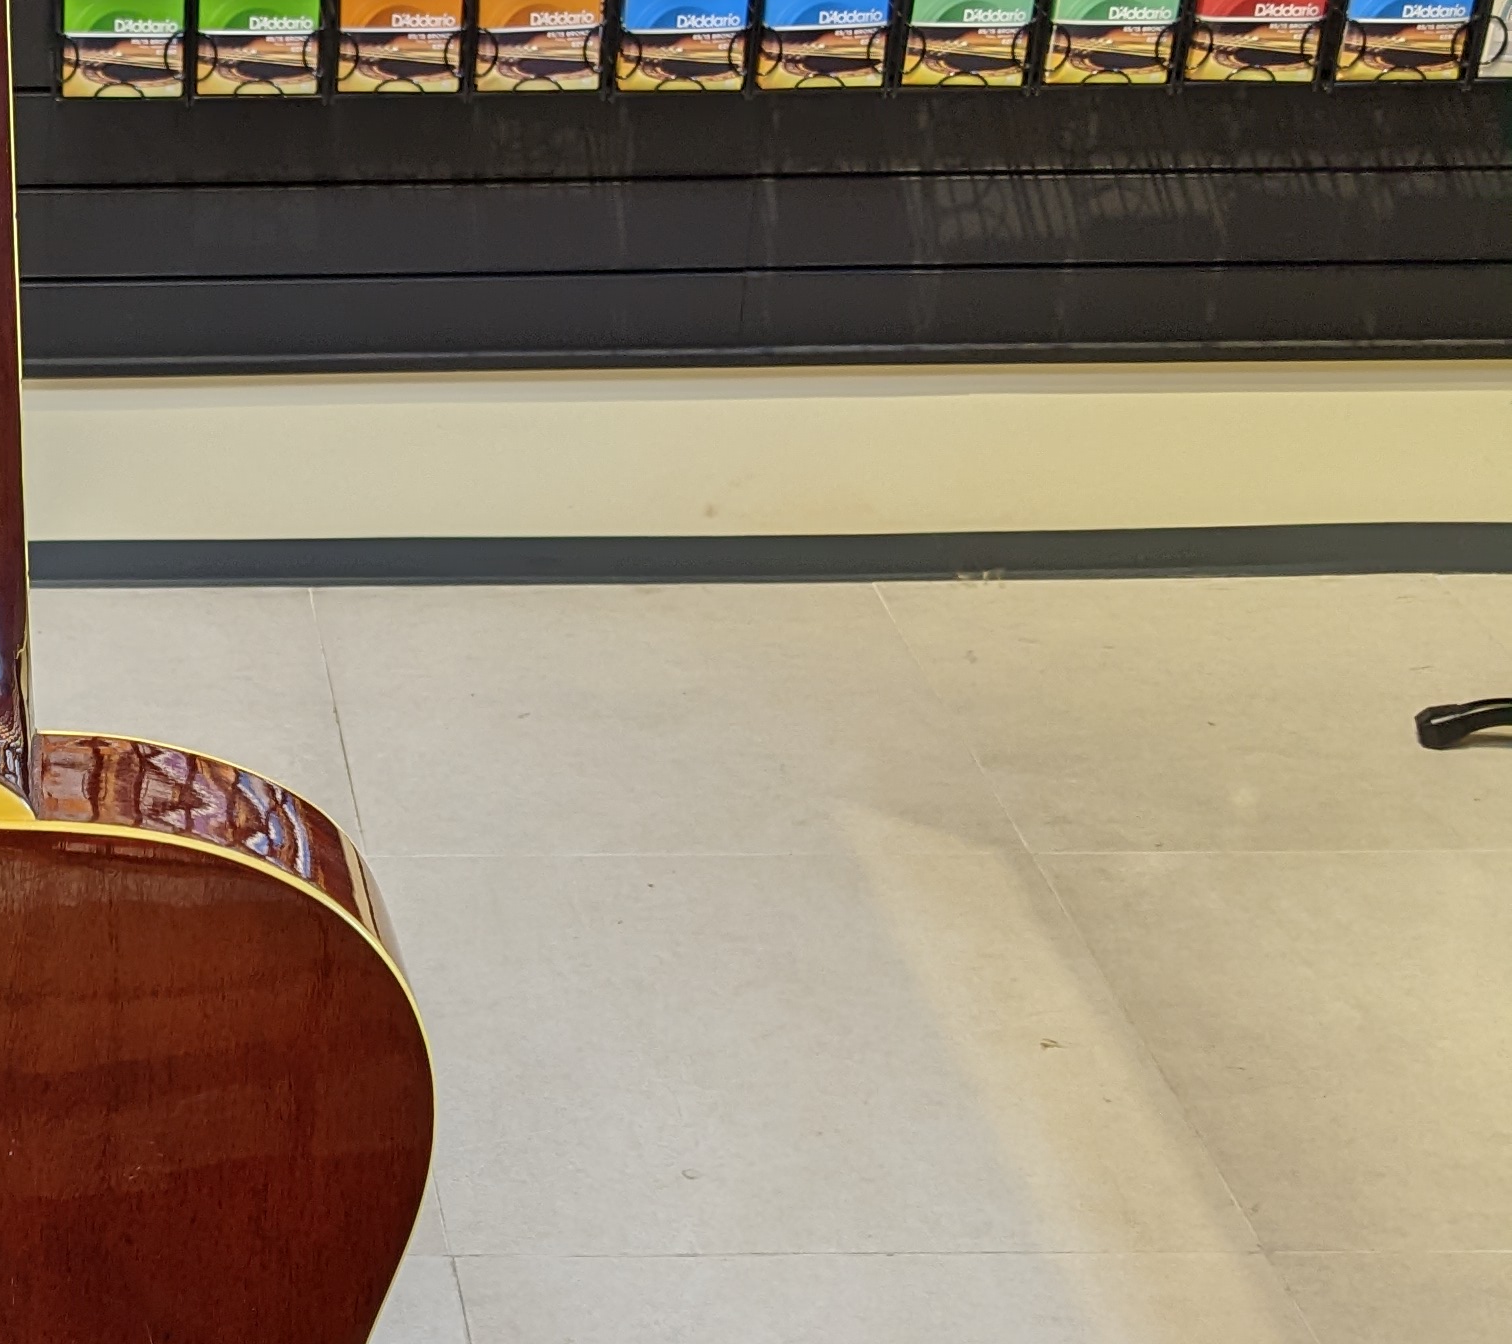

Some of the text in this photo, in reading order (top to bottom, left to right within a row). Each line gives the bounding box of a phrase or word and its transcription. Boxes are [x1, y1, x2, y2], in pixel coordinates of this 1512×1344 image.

[529, 8, 595, 27] D'Addario
[818, 7, 883, 24] D'Addario
[962, 7, 1026, 24] D'Addario
[1108, 4, 1173, 21] D'Addario
[1254, 2, 1321, 18] D'Addario
[1401, 3, 1466, 19] D'Addario
[113, 16, 179, 34] D'Addario
[248, 15, 315, 32] D'Addario
[391, 11, 457, 29] D'Addario
[676, 12, 741, 29] D'Addario
